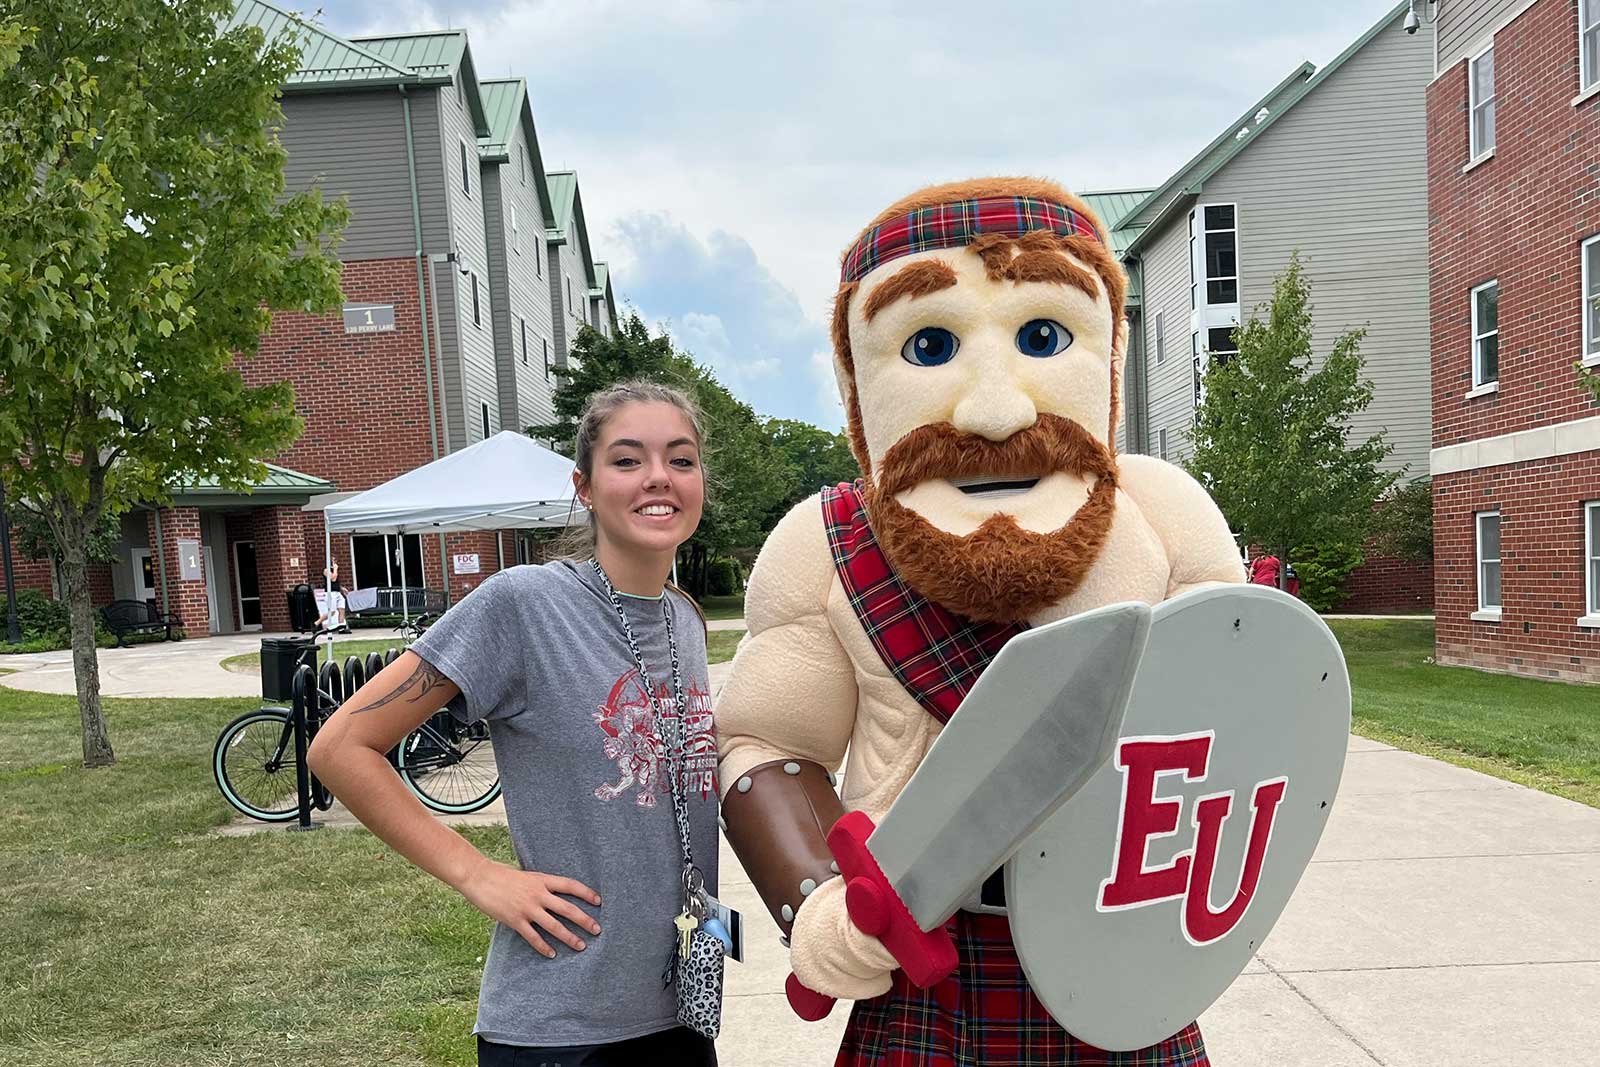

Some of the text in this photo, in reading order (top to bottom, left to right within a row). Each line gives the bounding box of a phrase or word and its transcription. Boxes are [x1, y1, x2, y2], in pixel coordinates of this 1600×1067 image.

[364, 310, 374, 325] 1
[189, 555, 197, 568] 1
[457, 555, 474, 563] FDC
[1096, 729, 1289, 946] EU
